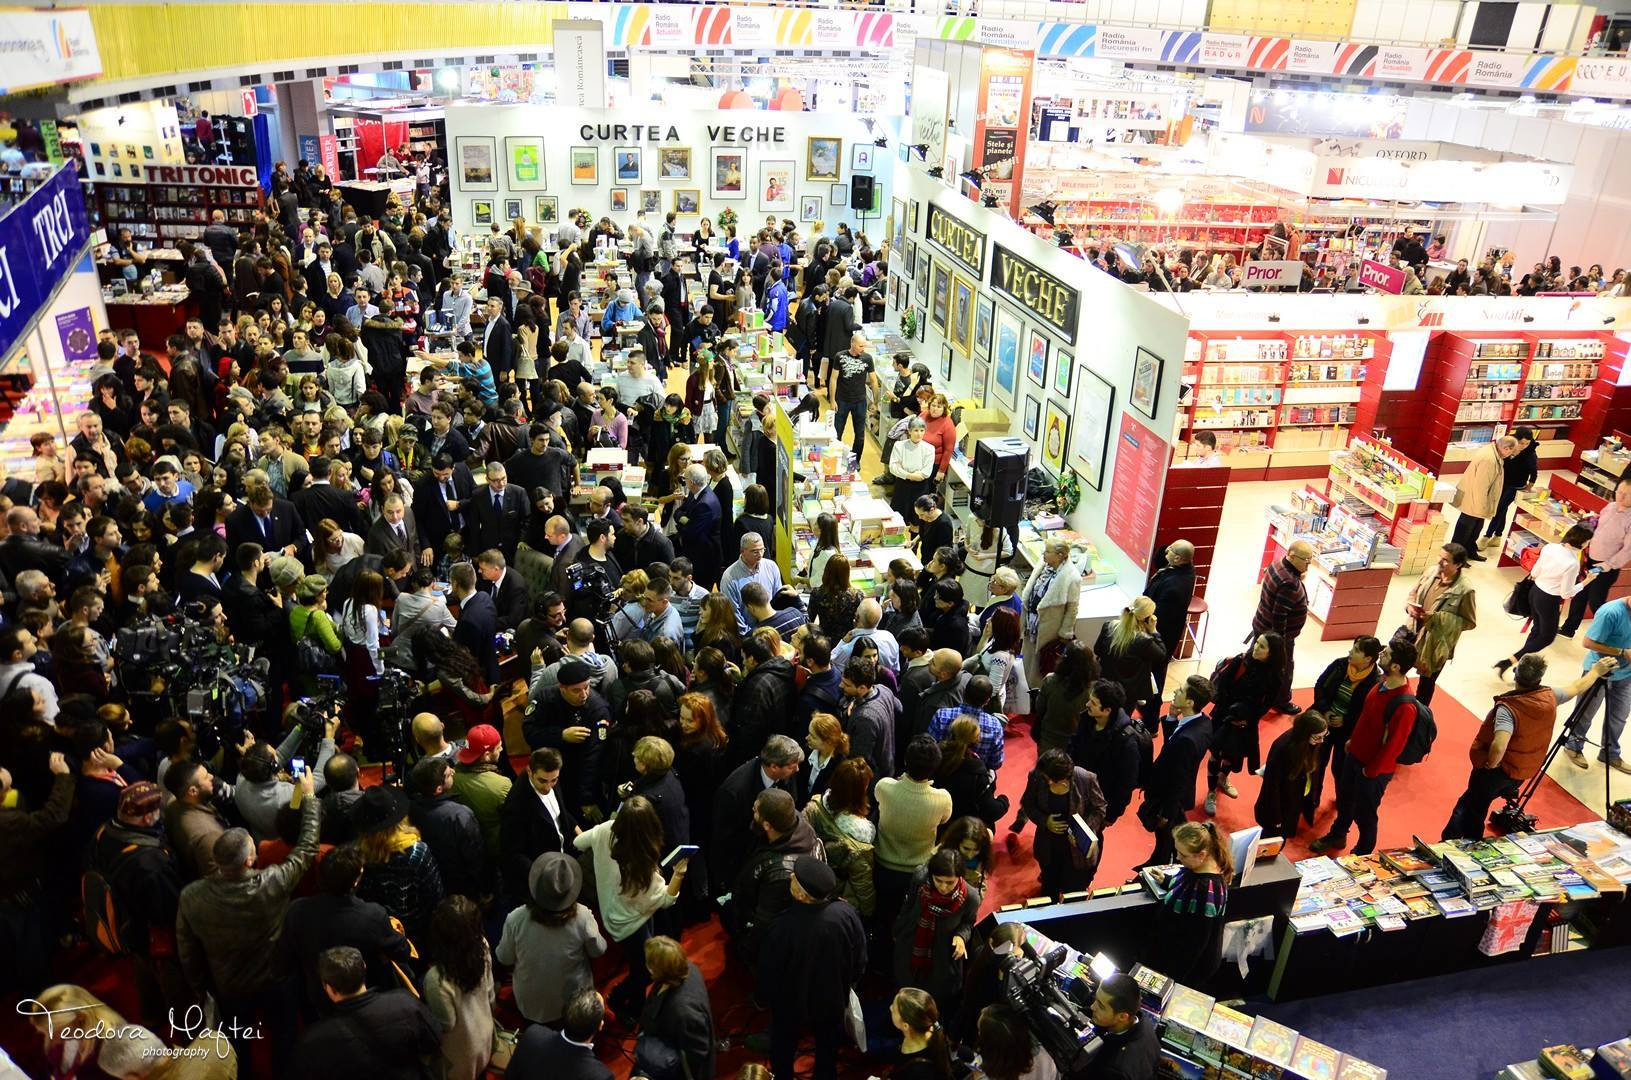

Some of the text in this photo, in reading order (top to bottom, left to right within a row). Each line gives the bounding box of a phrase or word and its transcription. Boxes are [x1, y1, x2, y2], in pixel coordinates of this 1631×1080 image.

[1102, 31, 1125, 39] Radio
[1477, 61, 1502, 70] Radio
[1475, 69, 1512, 79] România
[580, 124, 785, 143] CURTEA VECHE
[986, 140, 1005, 148] Stele
[986, 147, 1013, 155] planete
[1376, 149, 1428, 161] OXFORD
[144, 165, 256, 186] TRITONIC
[931, 210, 982, 269] CURTEA
[1247, 266, 1282, 280] Prior
[1361, 264, 1390, 287] Prior
[1001, 253, 1069, 327] VECHE
